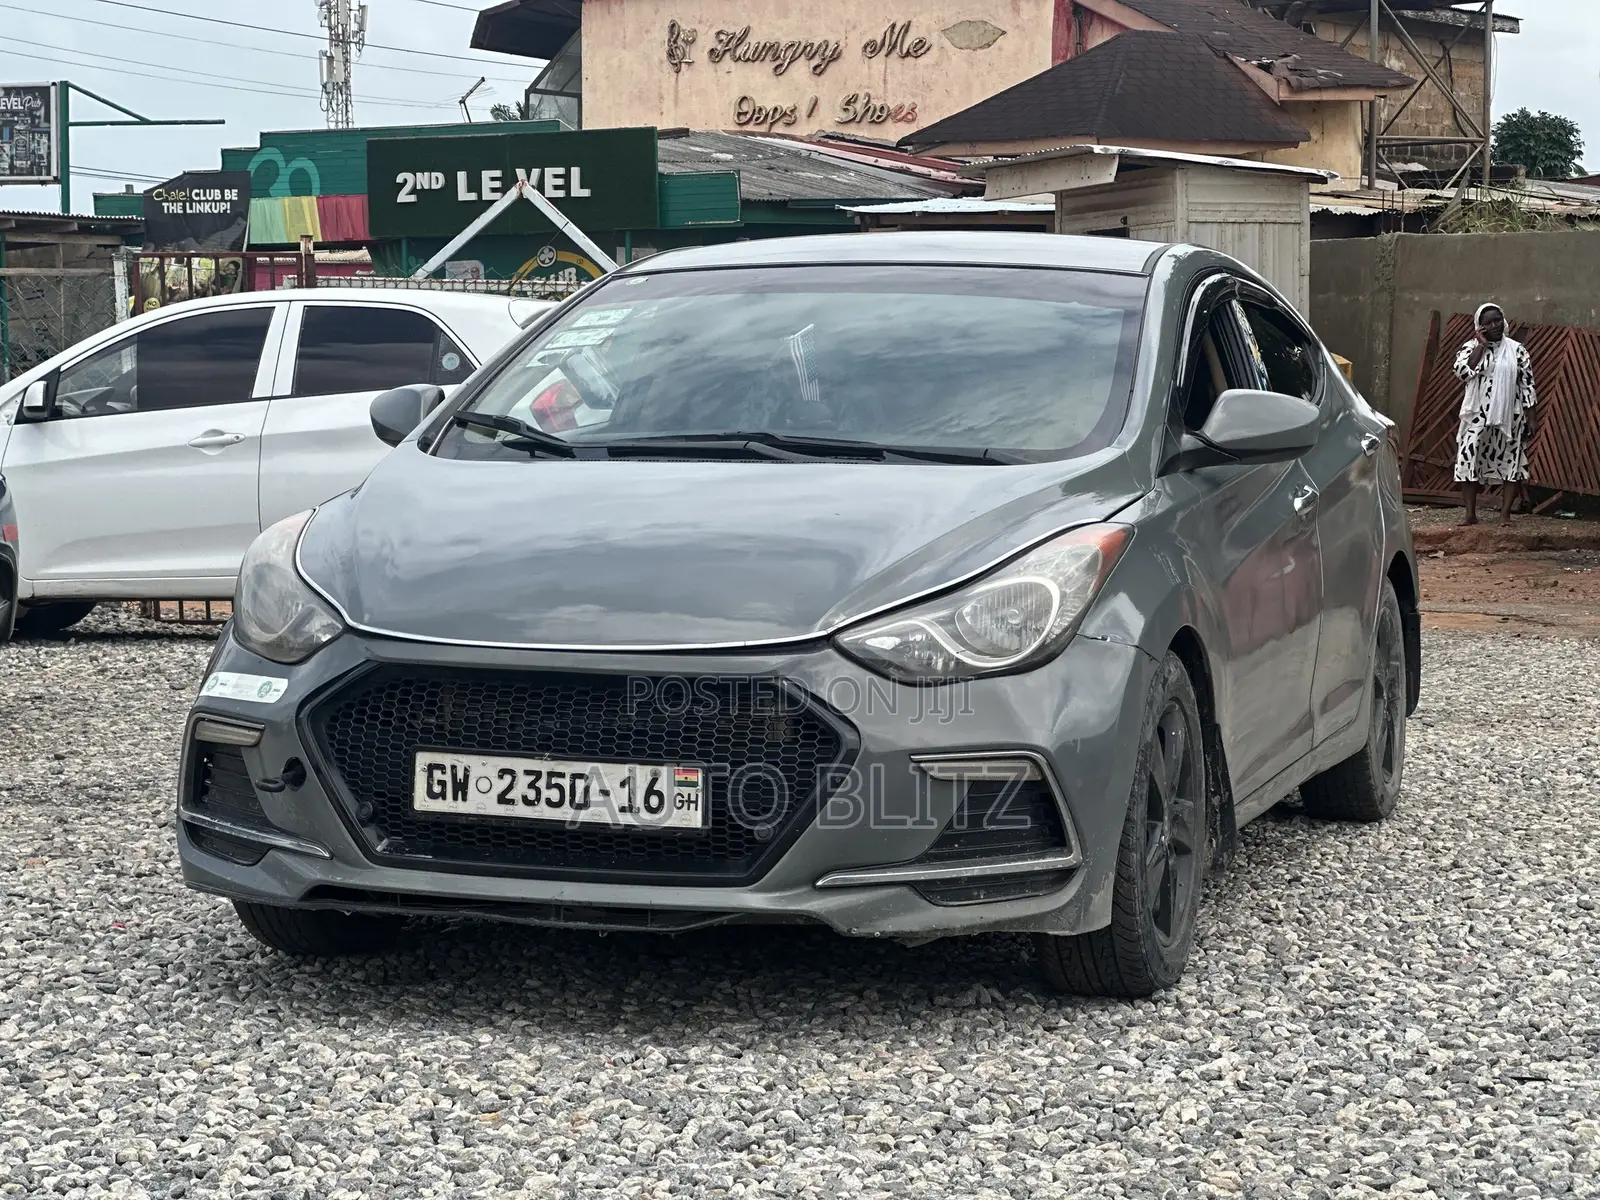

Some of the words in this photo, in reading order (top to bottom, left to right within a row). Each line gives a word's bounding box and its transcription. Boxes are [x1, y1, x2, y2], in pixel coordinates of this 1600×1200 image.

[861, 20, 933, 59] Me
[0, 97, 24, 109] EVEL
[835, 92, 918, 124] Shoes
[152, 188, 189, 201] Chale!
[191, 188, 221, 201] CLUB
[224, 188, 238, 200] BE
[396, 171, 444, 203] 2ND
[162, 202, 183, 214] THE
[186, 202, 231, 214] LINKUP!
[425, 763, 470, 802] GW
[673, 792, 699, 812] GH
